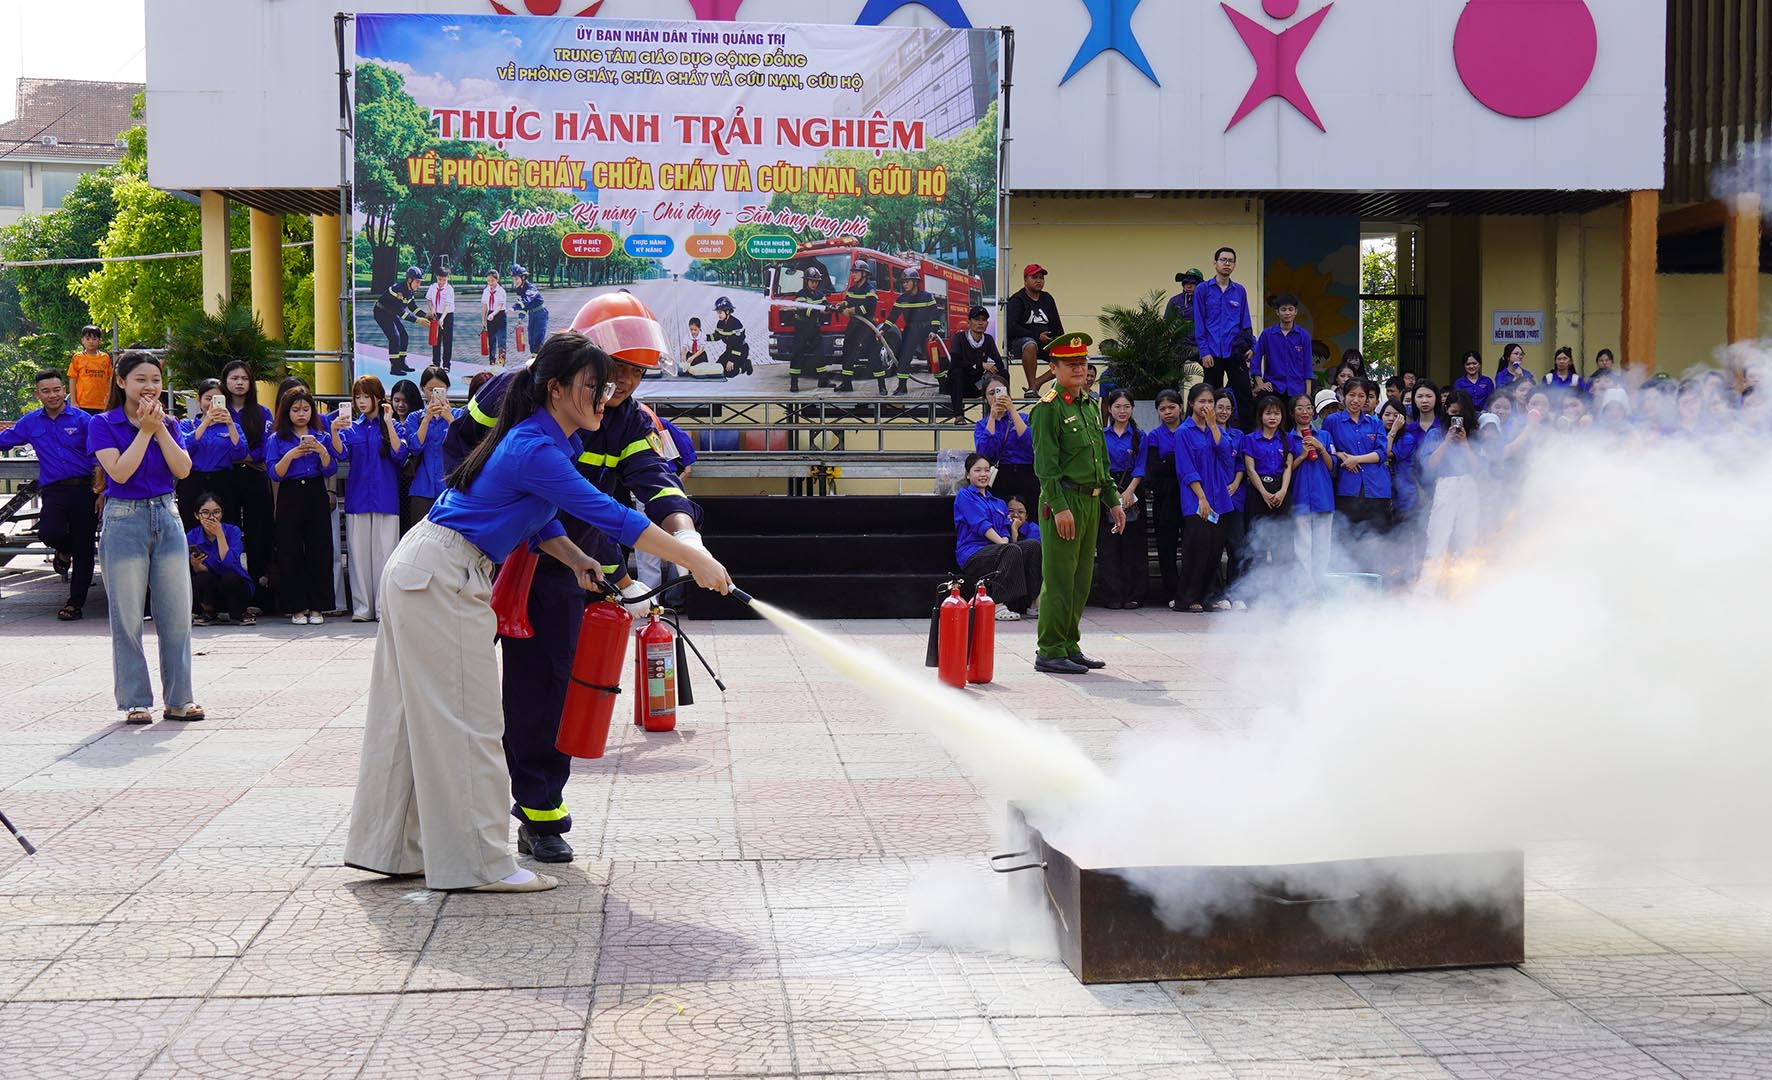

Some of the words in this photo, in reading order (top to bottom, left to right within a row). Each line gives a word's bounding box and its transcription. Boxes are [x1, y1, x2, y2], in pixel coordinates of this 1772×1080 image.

[577, 25, 592, 41] ỦY
[596, 29, 622, 41] BAN
[625, 30, 659, 43] NHÂN
[662, 30, 688, 43] DÂN
[691, 29, 719, 44] TỈNH
[722, 30, 764, 45] QUẢNG
[767, 33, 785, 47] TRỊ
[555, 48, 602, 62] TRUNG
[606, 47, 636, 63] TÂM
[639, 49, 677, 65] GIÁO
[680, 52, 712, 68] DỤC
[715, 50, 761, 69] CỘNG
[763, 48, 807, 67] ĐỒNG
[497, 62, 515, 81] VỀ
[518, 65, 571, 82] PHÒNG
[574, 67, 618, 85] CHÁY,
[621, 69, 663, 85] CHỮA
[666, 70, 708, 86] CHÁY
[711, 70, 732, 86] VÀ
[735, 71, 765, 87] CỨU
[768, 74, 804, 90] NẠN,
[807, 72, 838, 89] CỨU
[841, 73, 863, 92] HỘ
[432, 105, 541, 149] THỰC
[554, 103, 661, 144] HÀNH
[673, 106, 763, 156] TRẢI
[776, 110, 925, 158] NGHIỆM
[407, 151, 436, 187] VỀ
[441, 153, 520, 187] PHÒNG
[524, 155, 587, 191] CHÁY,
[592, 156, 654, 191] CHỮA
[659, 158, 719, 192] CHÁY
[722, 159, 753, 192] VÀ
[757, 160, 803, 193] CỨU
[807, 166, 863, 199] NẠN,
[868, 163, 912, 197] CỨU
[917, 165, 948, 203] HỘ
[488, 209, 520, 235] An
[522, 207, 555, 230] toàn
[570, 202, 599, 230] Kỹ
[601, 205, 638, 226] năng
[653, 202, 685, 221] Chủ
[686, 203, 721, 226] động
[736, 205, 772, 225] Sẵn
[773, 207, 808, 233] sàng
[809, 209, 837, 237] ứng
[837, 215, 870, 239] phó
